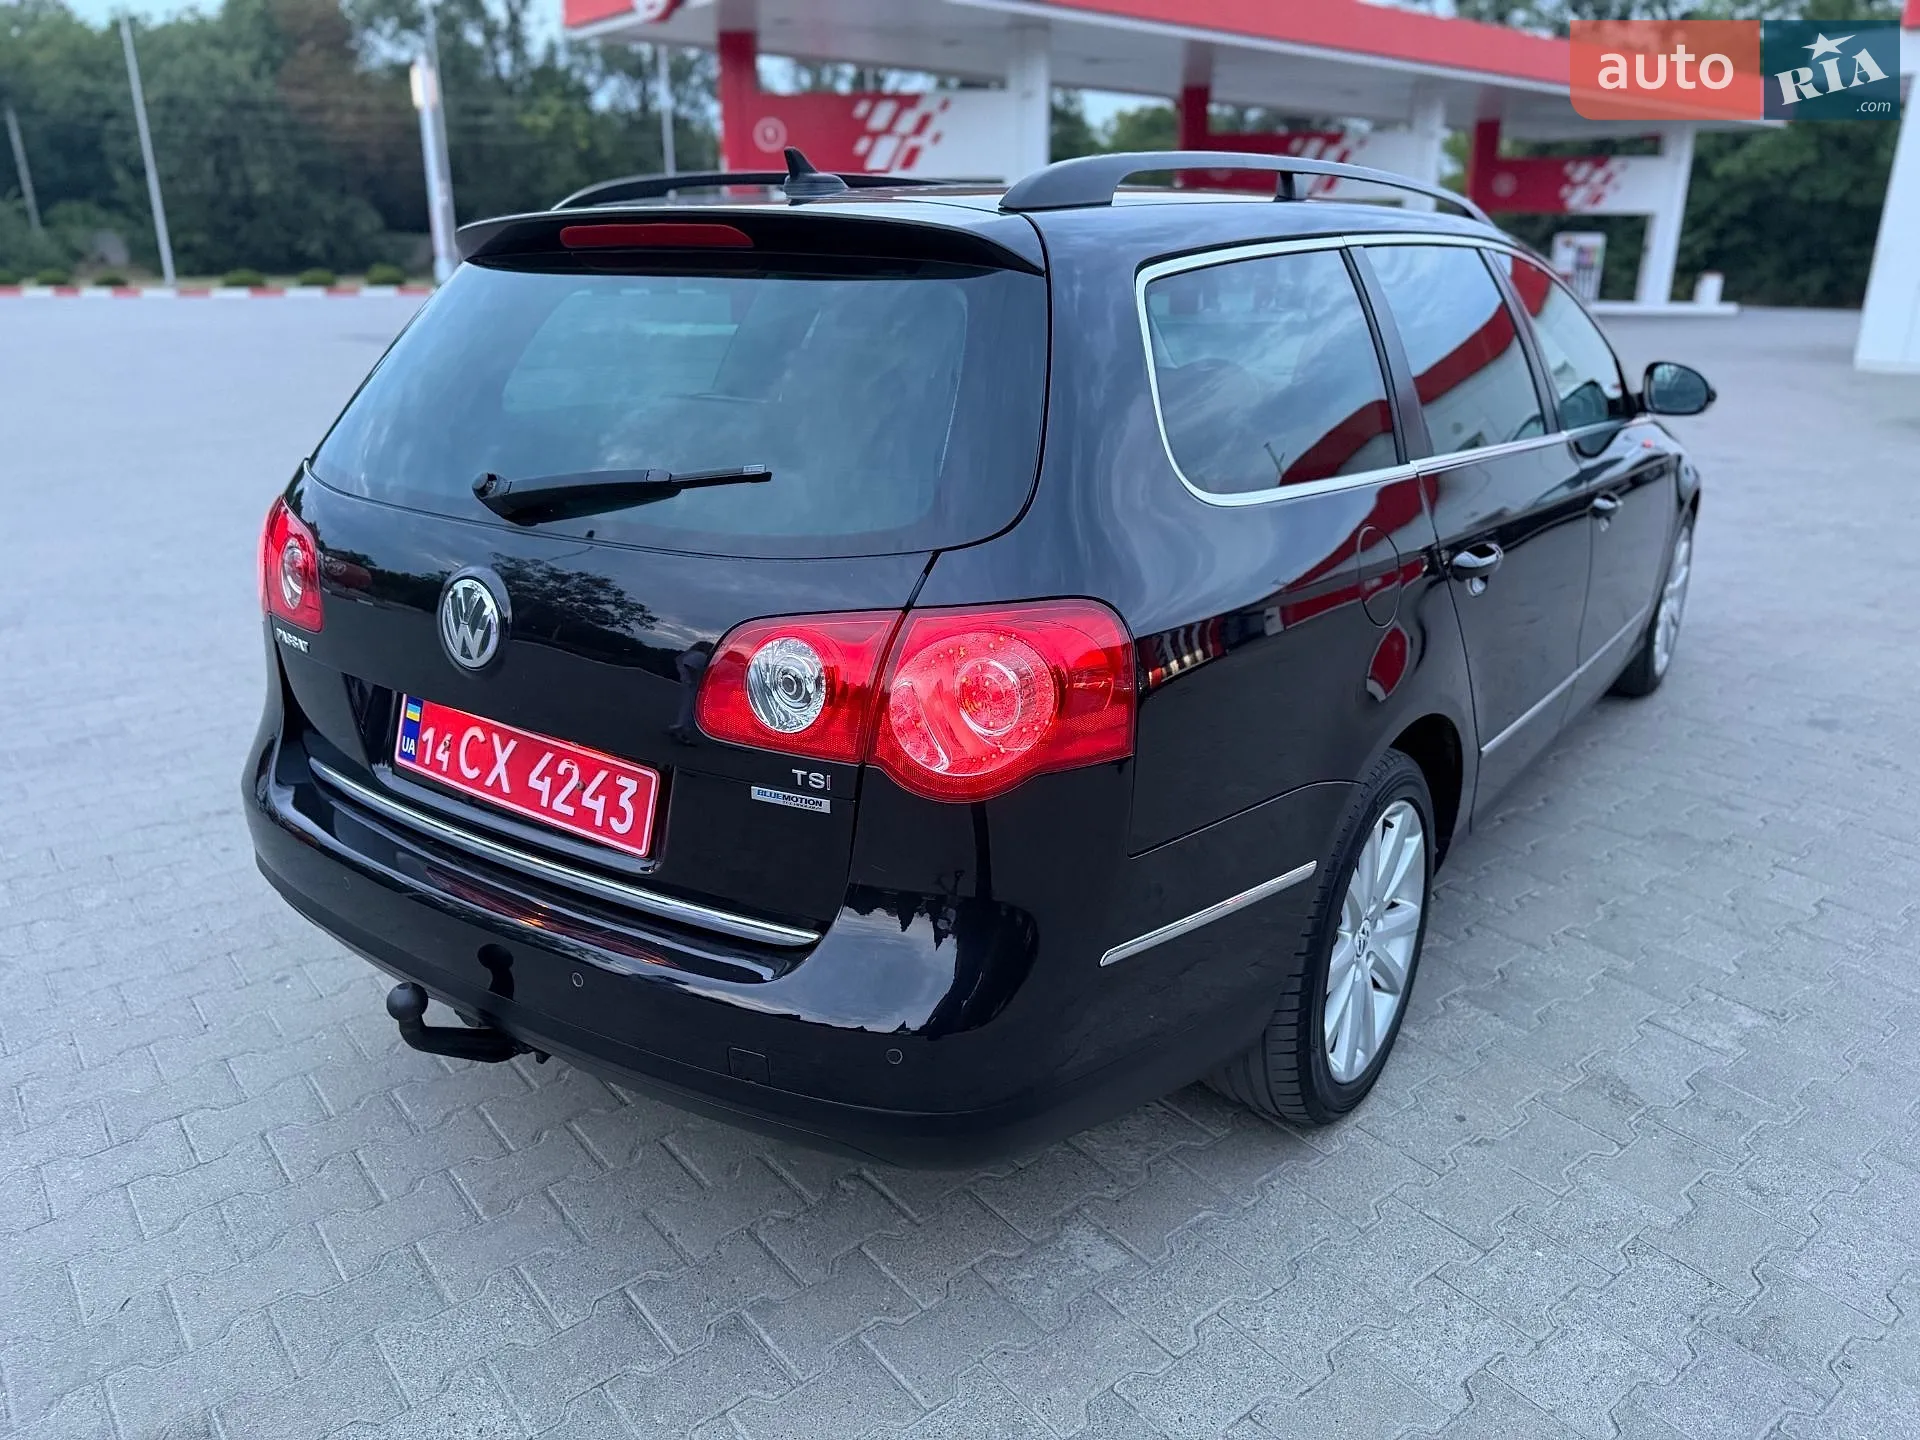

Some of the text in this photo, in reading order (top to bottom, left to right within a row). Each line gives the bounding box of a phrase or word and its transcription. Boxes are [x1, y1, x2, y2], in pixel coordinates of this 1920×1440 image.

[401, 735, 416, 756] UA
[527, 751, 639, 835] 4243
[756, 788, 823, 808] BLUEMOTION
